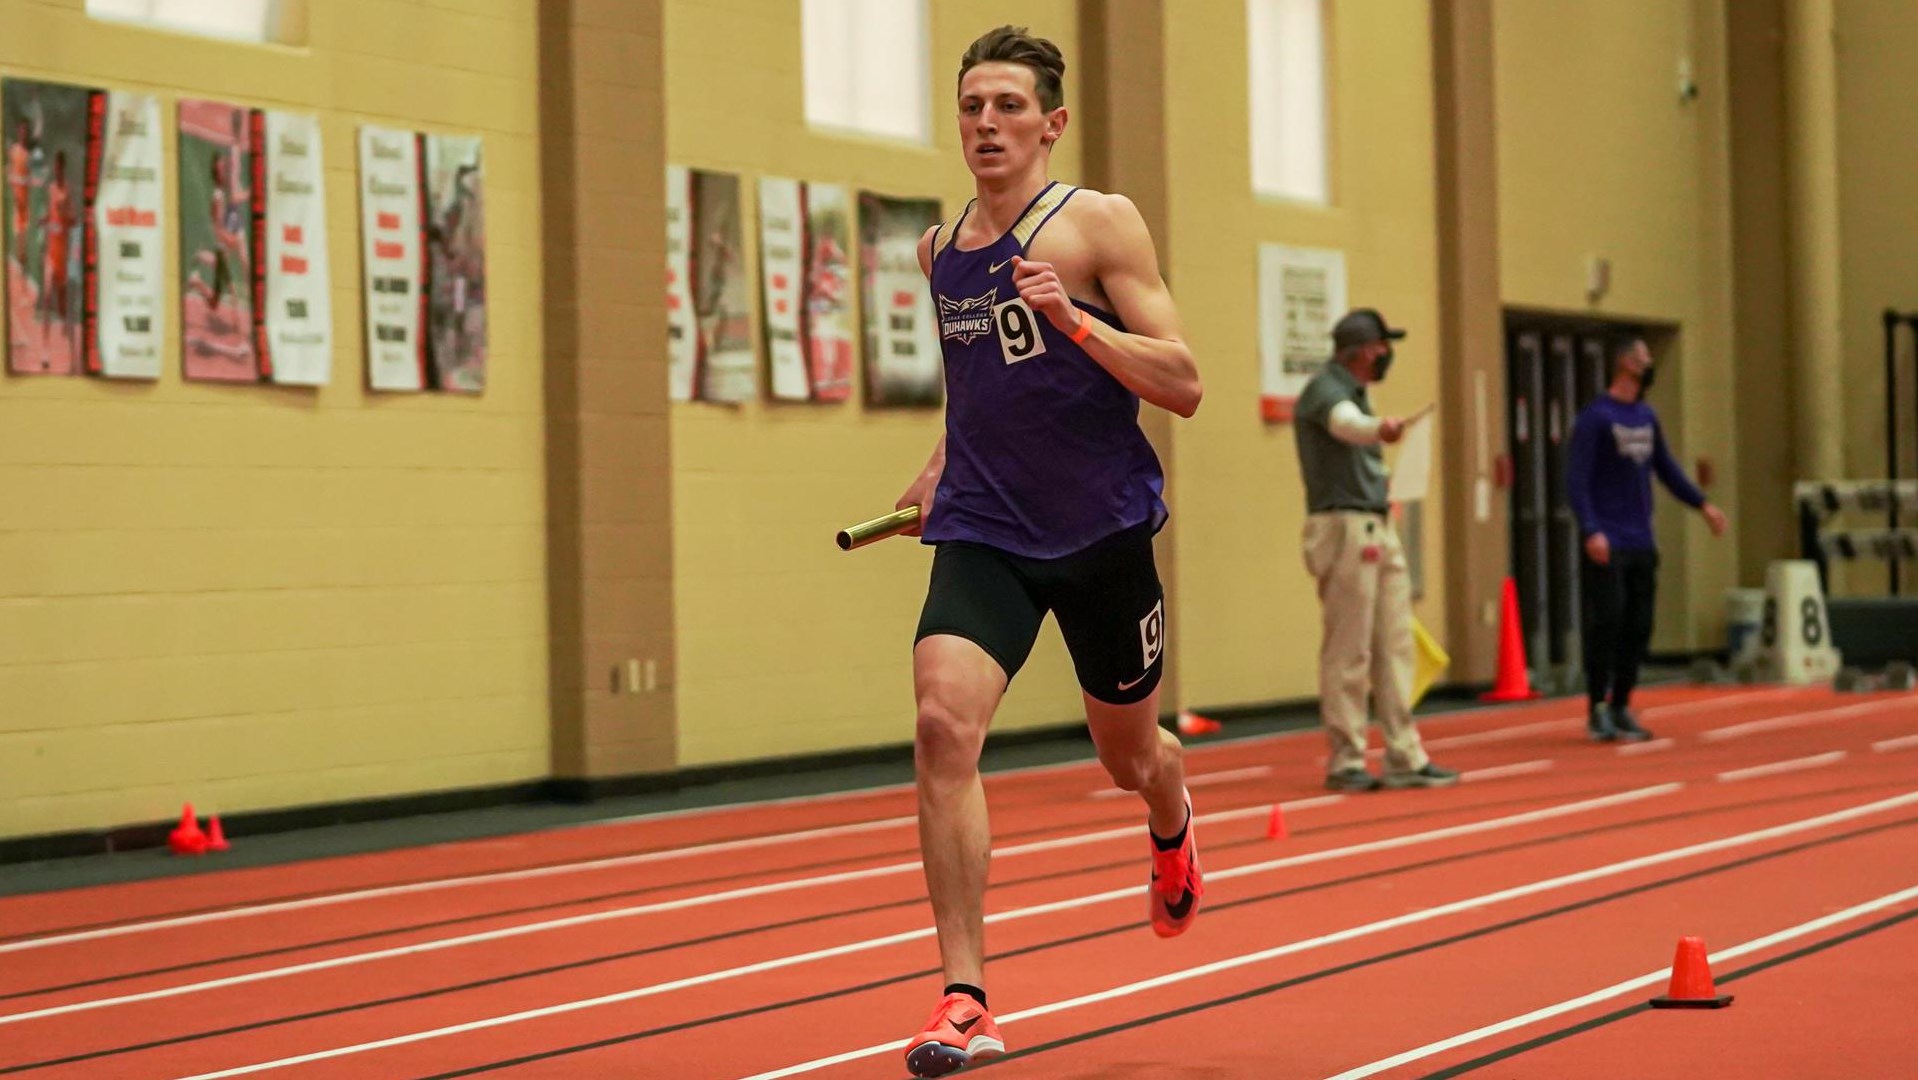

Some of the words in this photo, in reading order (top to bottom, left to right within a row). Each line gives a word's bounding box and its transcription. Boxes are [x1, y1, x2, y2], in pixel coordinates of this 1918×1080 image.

[1000, 303, 1035, 357] 9
[1145, 610, 1161, 660] 9
[1801, 596, 1822, 647] 8
